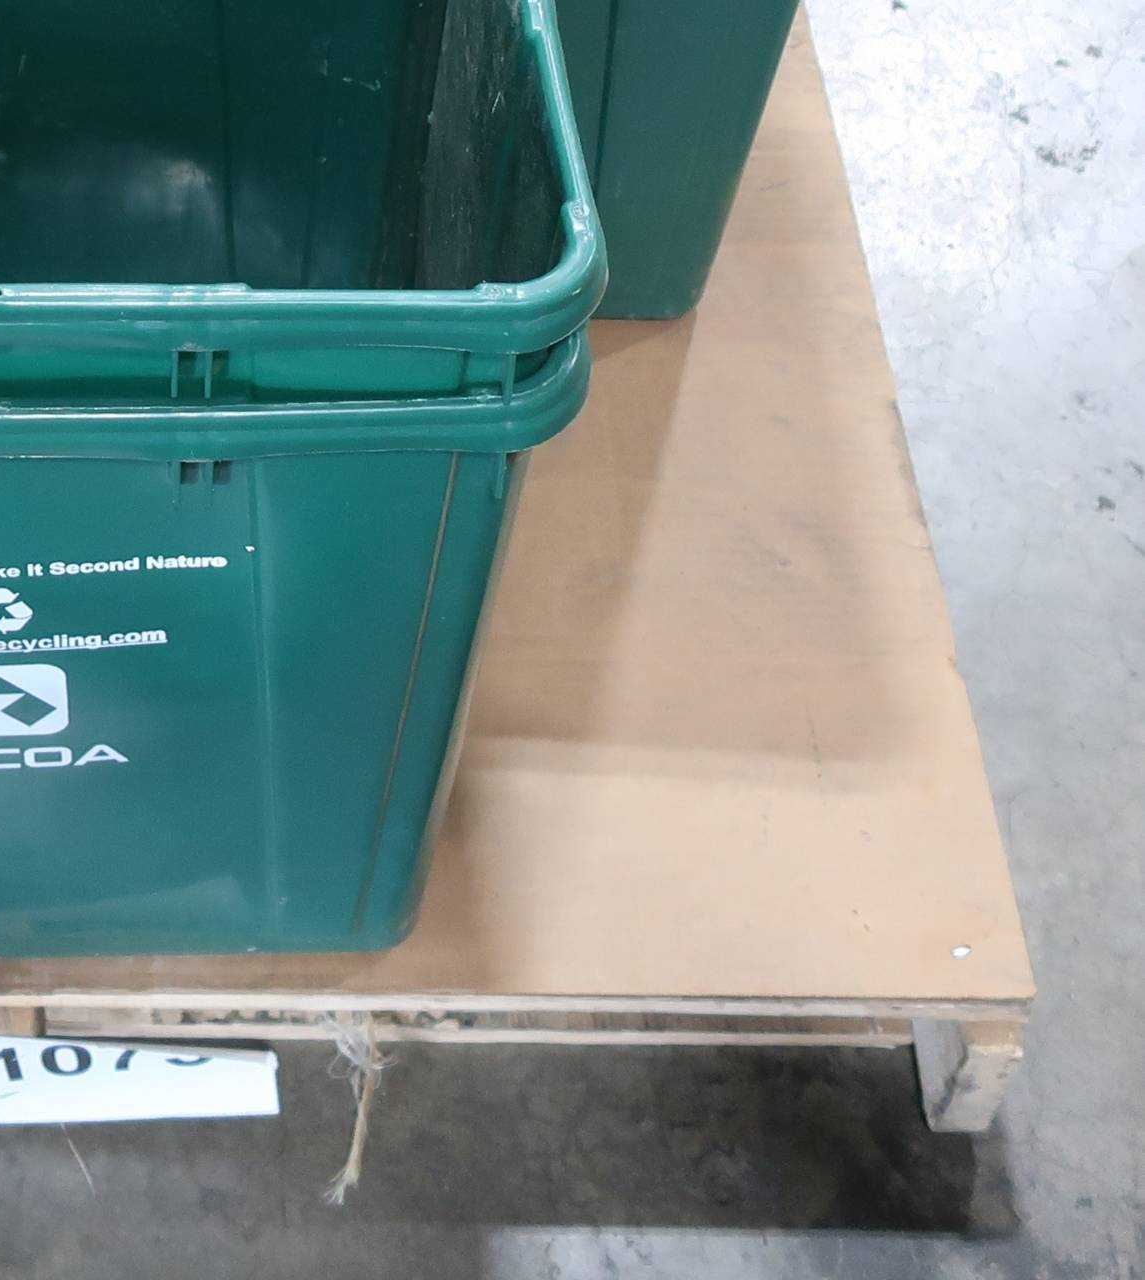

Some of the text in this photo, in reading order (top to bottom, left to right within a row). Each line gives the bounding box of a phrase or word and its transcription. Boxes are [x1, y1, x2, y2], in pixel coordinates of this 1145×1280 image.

[26, 563, 44, 577] It
[49, 556, 140, 576] Second
[146, 554, 228, 570] Nature
